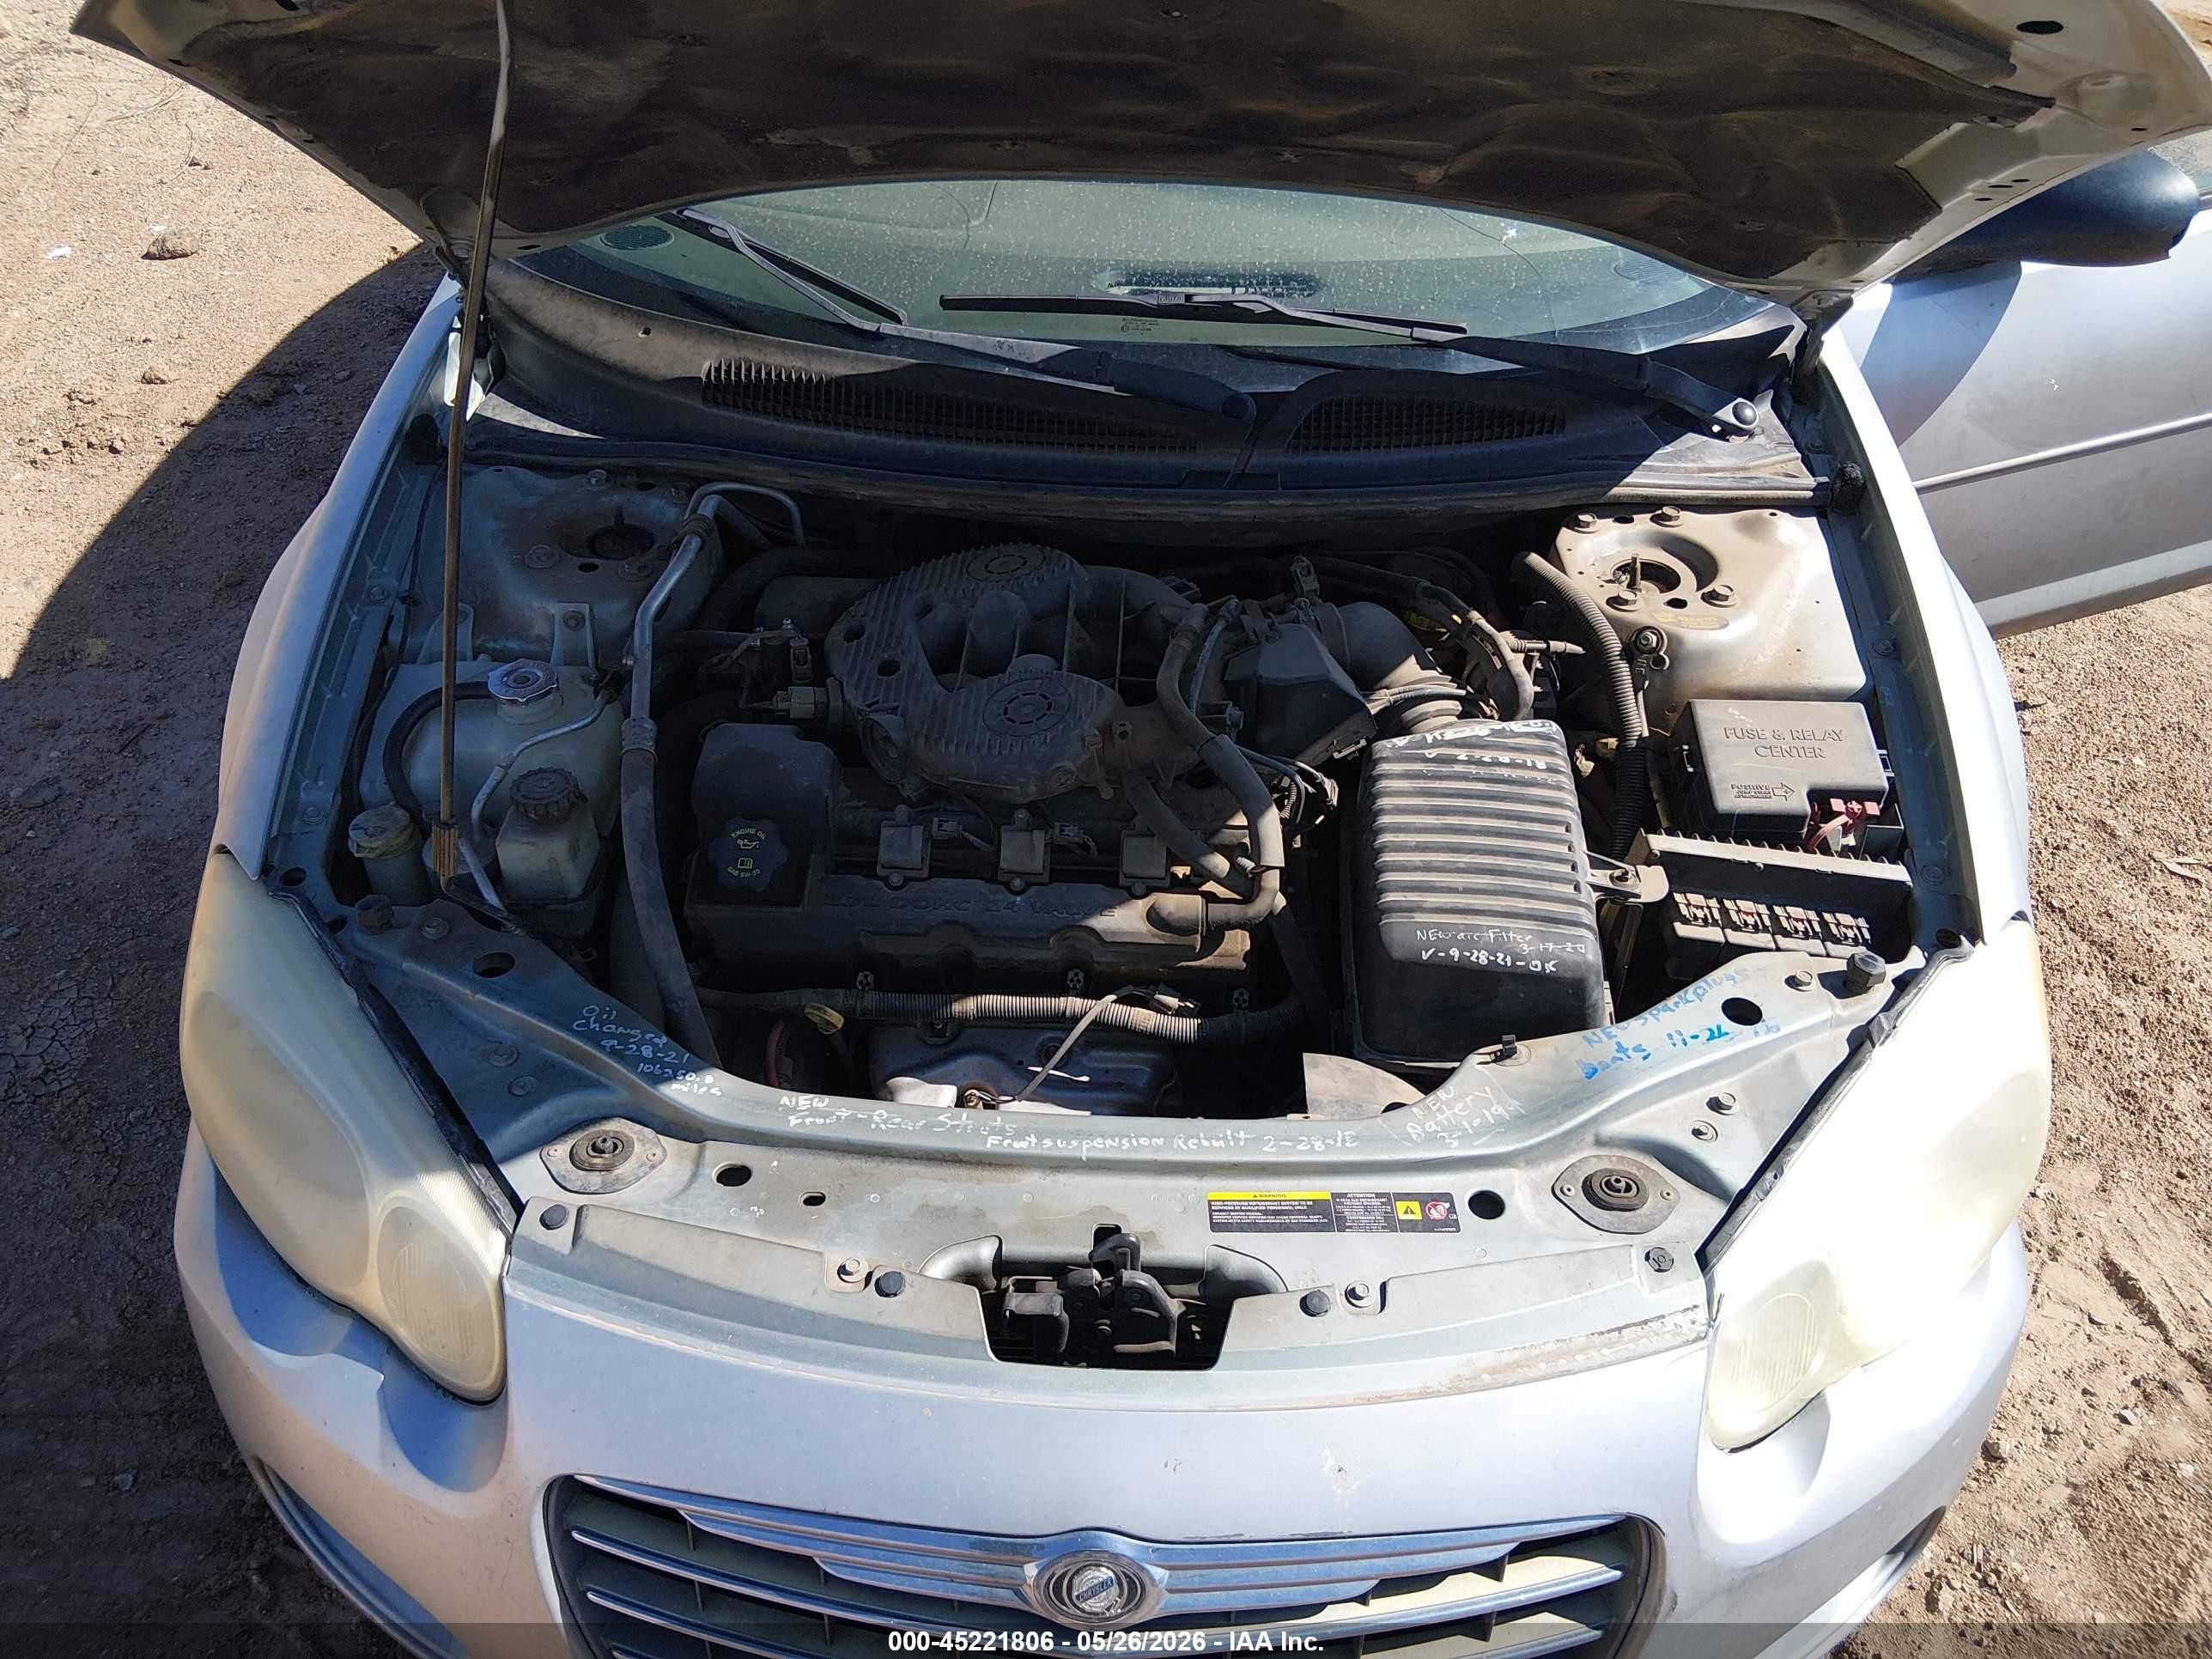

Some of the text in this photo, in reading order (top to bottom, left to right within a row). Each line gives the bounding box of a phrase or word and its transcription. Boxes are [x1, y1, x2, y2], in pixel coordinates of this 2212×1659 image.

[1723, 726, 1844, 742] FUSE & RELAY
[1754, 744, 1826, 759] CENTER
[731, 827, 767, 841] ENGINE OIL
[1078, 1577, 1114, 1601] CHRYSLER
